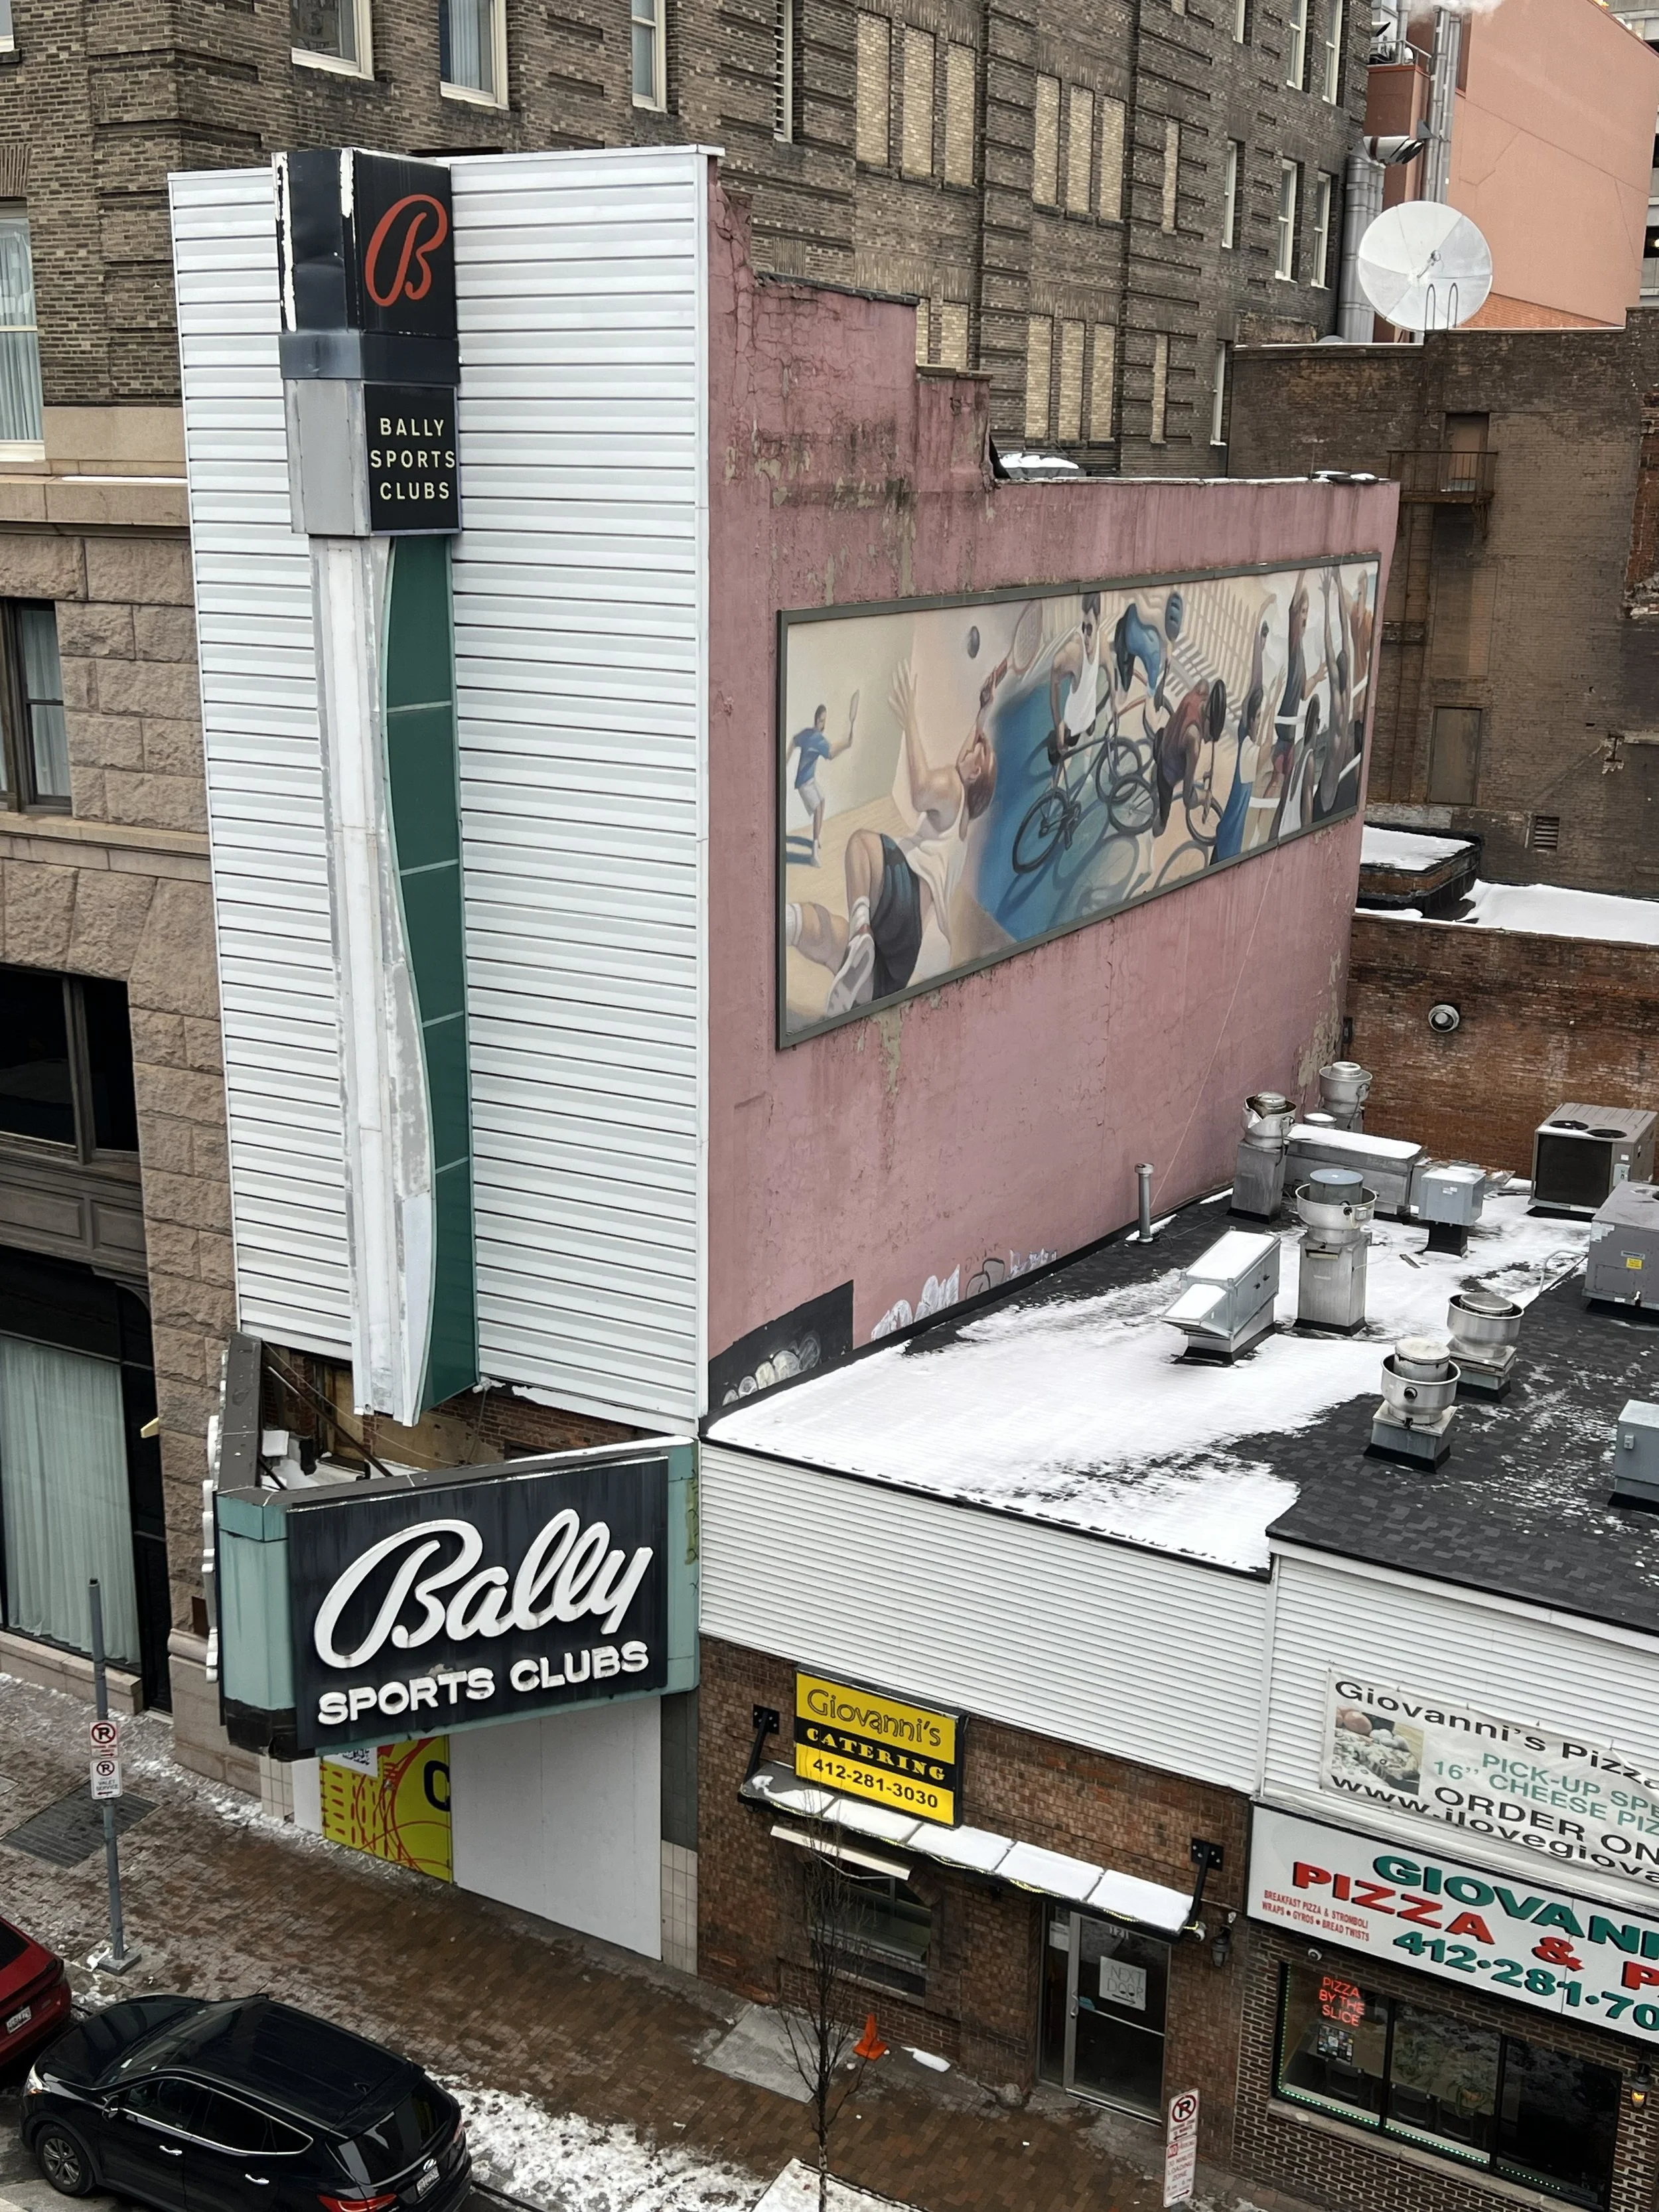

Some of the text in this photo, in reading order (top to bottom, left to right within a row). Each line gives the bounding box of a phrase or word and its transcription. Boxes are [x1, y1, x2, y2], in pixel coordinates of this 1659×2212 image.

[380, 417, 445, 437] BALLY
[370, 449, 456, 469] SPORTS
[380, 482, 451, 501] CLUBS
[314, 1509, 654, 1669] Bally
[318, 1641, 649, 1726] SPORTS CLUBS
[807, 1689, 942, 1747] Giovanni's
[1335, 1680, 1546, 1752] Giovanni's
[807, 1728, 945, 1781] CATERING
[1482, 1753, 1601, 1797] PICK-UP
[813, 1759, 938, 1808] 412-281-3030
[1489, 1773, 1607, 1821] CHEESE
[1435, 1786, 1659, 1866] ORDER ON
[1262, 1901, 1370, 1942] WRAPS GYROS BREAD TWISTS
[1264, 1889, 1301, 1908] BREAKFAST
[1303, 1901, 1321, 1915] PIZZA
[1332, 1910, 1368, 1929] STROMBOLI
[1293, 1861, 1495, 1945] PIZZA
[1531, 1937, 1585, 1972] &
[1107, 1978, 1144, 2002] DOOR
[1111, 1965, 1145, 1987] NEXT
[1323, 1976, 1360, 2000] PIZZA
[1319, 1989, 1365, 2016] BY THE
[1322, 2004, 1360, 2027] SLICE
